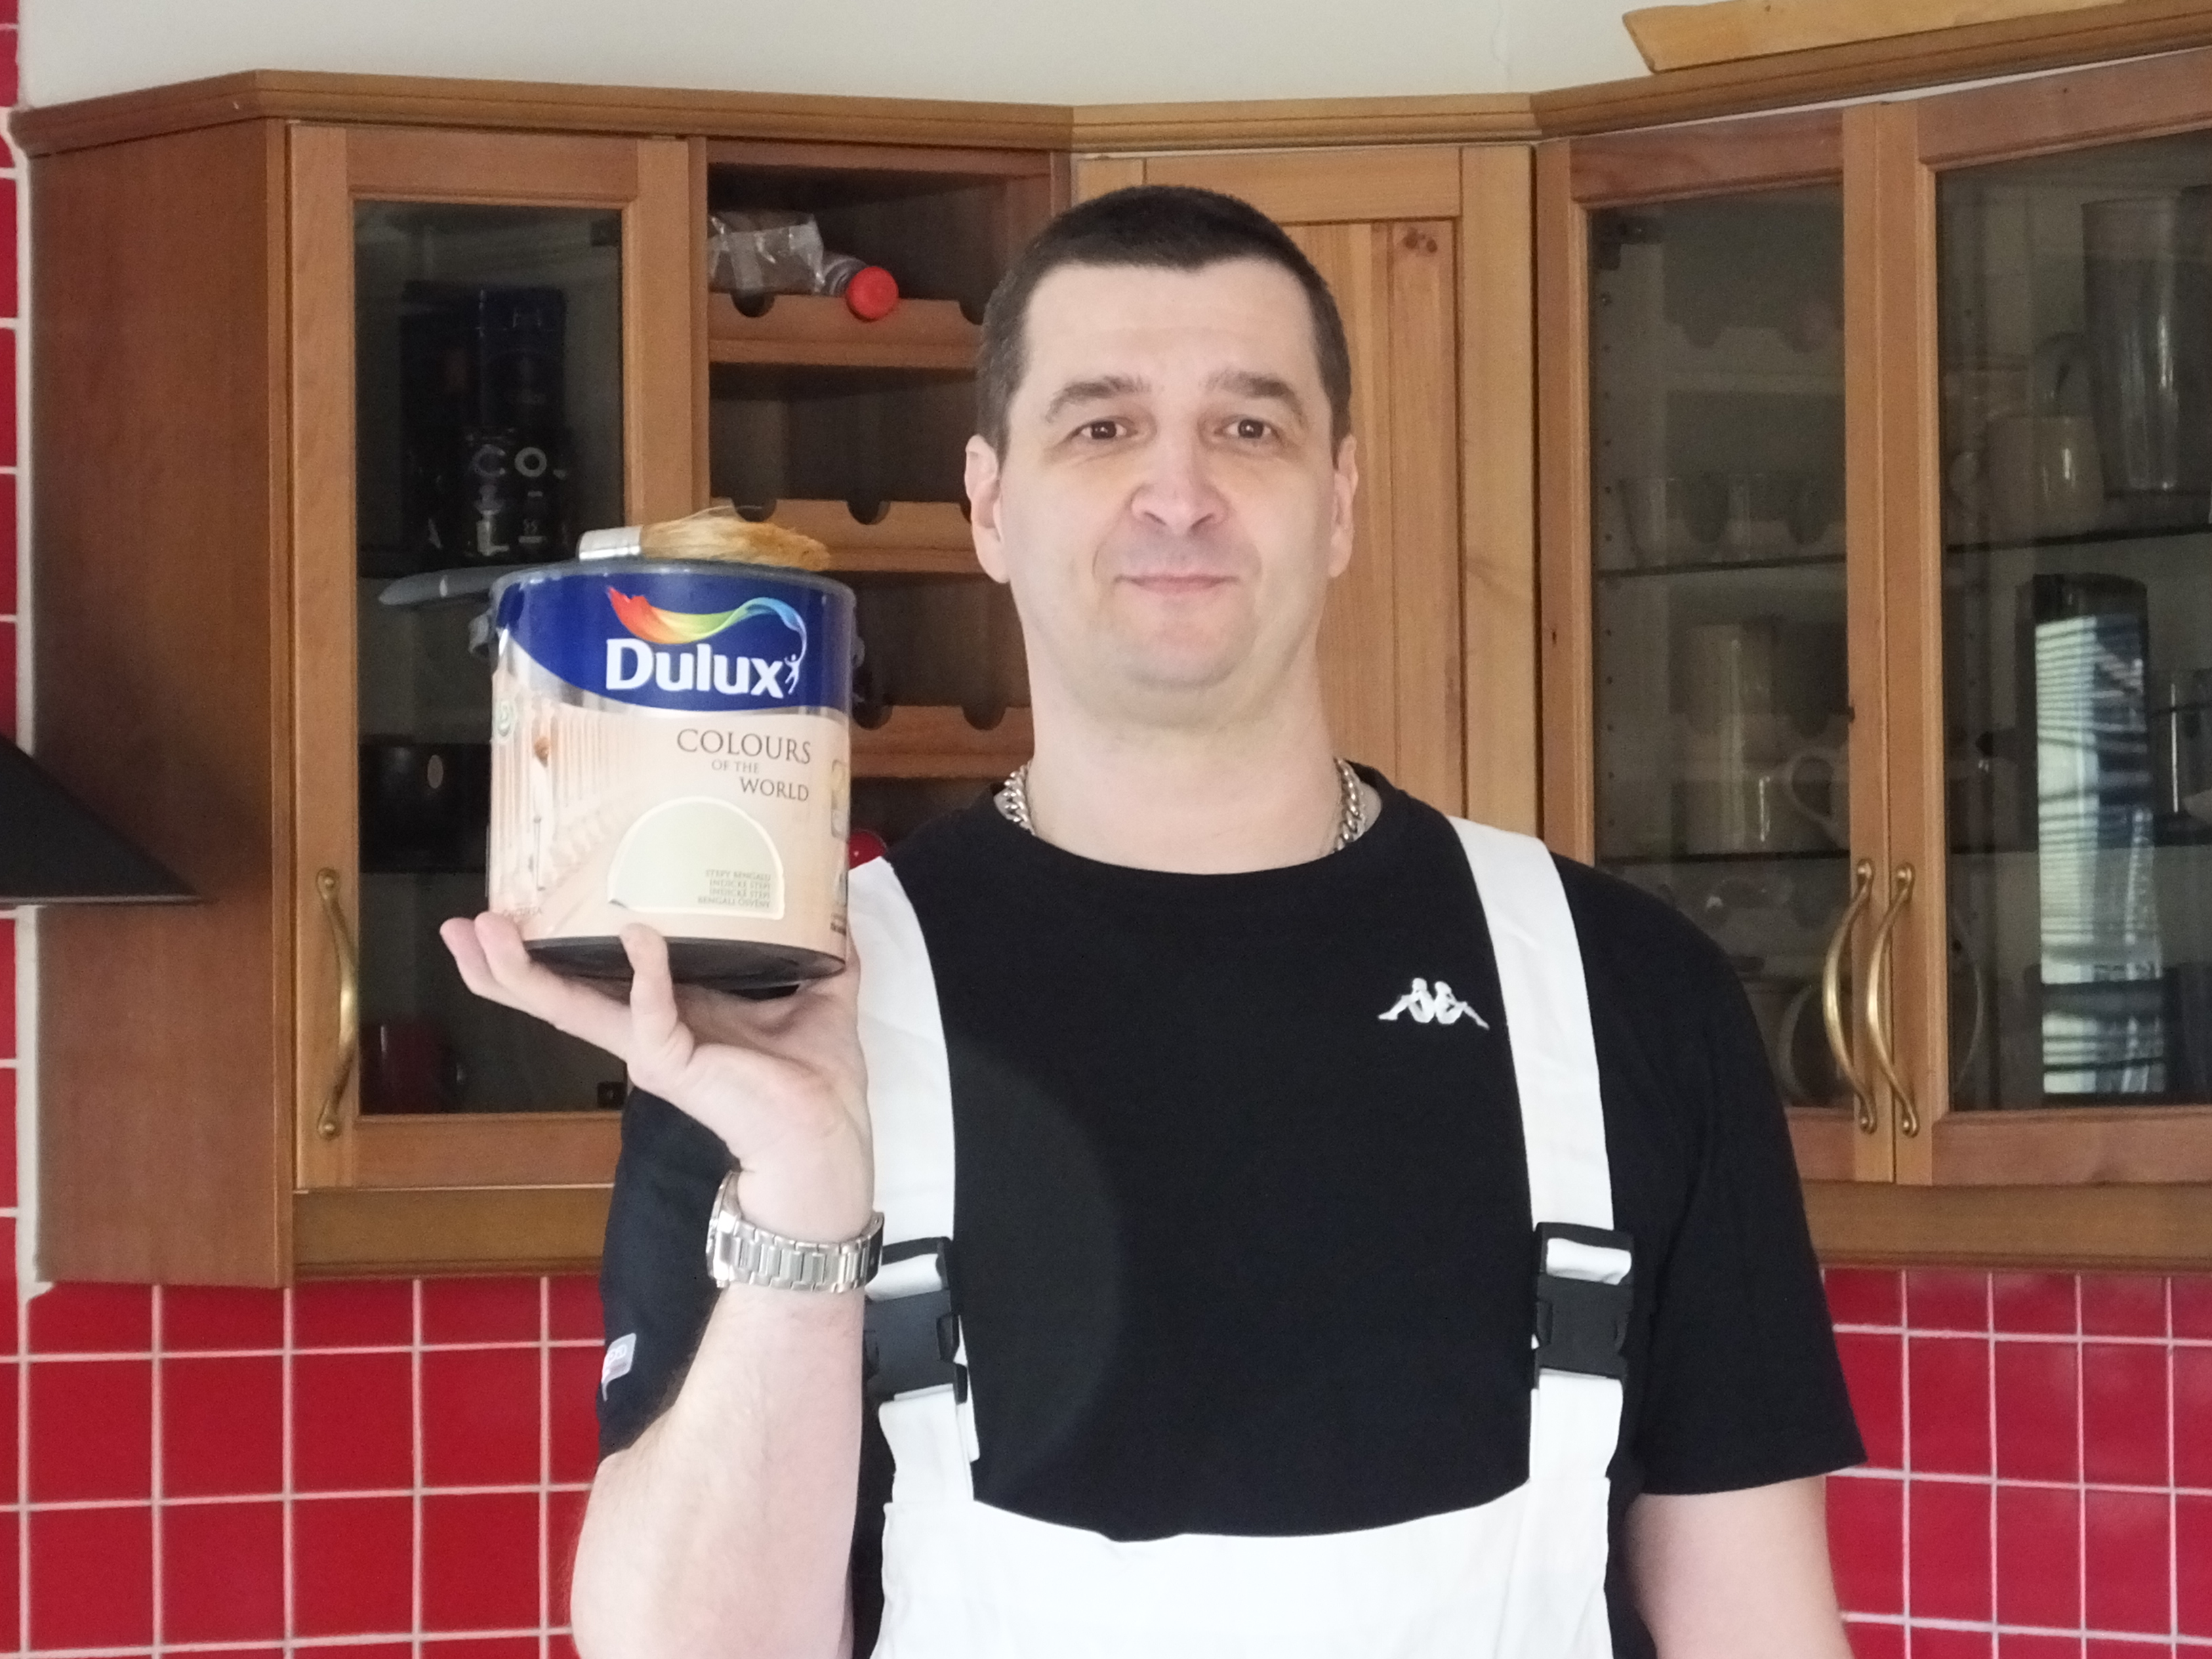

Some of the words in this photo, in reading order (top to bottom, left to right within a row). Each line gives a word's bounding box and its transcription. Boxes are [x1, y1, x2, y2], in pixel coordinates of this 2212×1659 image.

[606, 638, 783, 699] Dulux
[677, 728, 811, 764] COLOURS
[711, 759, 730, 771] OF
[734, 760, 760, 775] THE
[739, 776, 809, 802] WORLD
